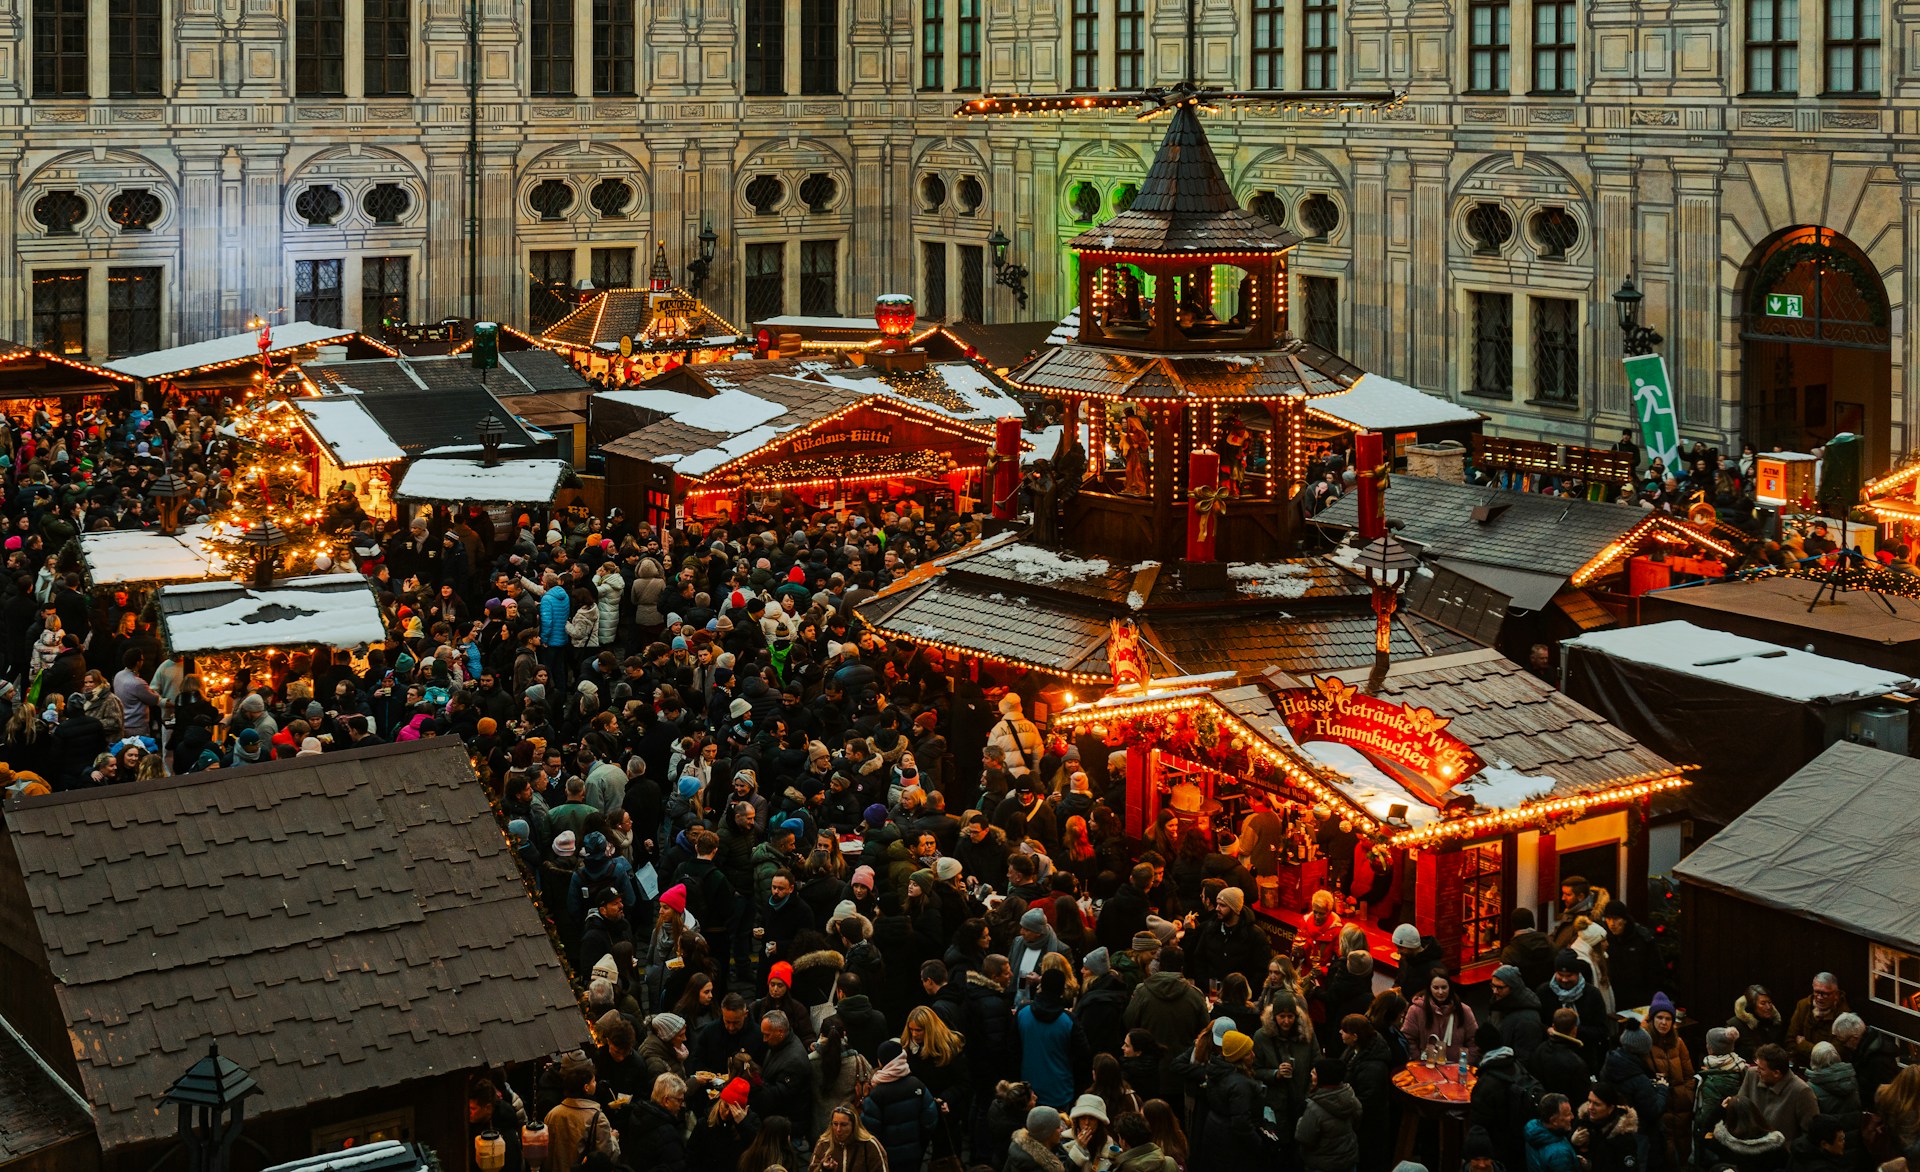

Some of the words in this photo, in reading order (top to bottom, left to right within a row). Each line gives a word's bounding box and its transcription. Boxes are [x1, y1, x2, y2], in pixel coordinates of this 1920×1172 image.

[656, 300, 698, 313] KARTOFFEL
[1281, 695, 1334, 716] Heisse
[1338, 699, 1412, 733] Getränke
[1428, 732, 1469, 773] Wein
[1315, 719, 1431, 769] Flammkuchen
[1291, 788, 1307, 801] Wein
